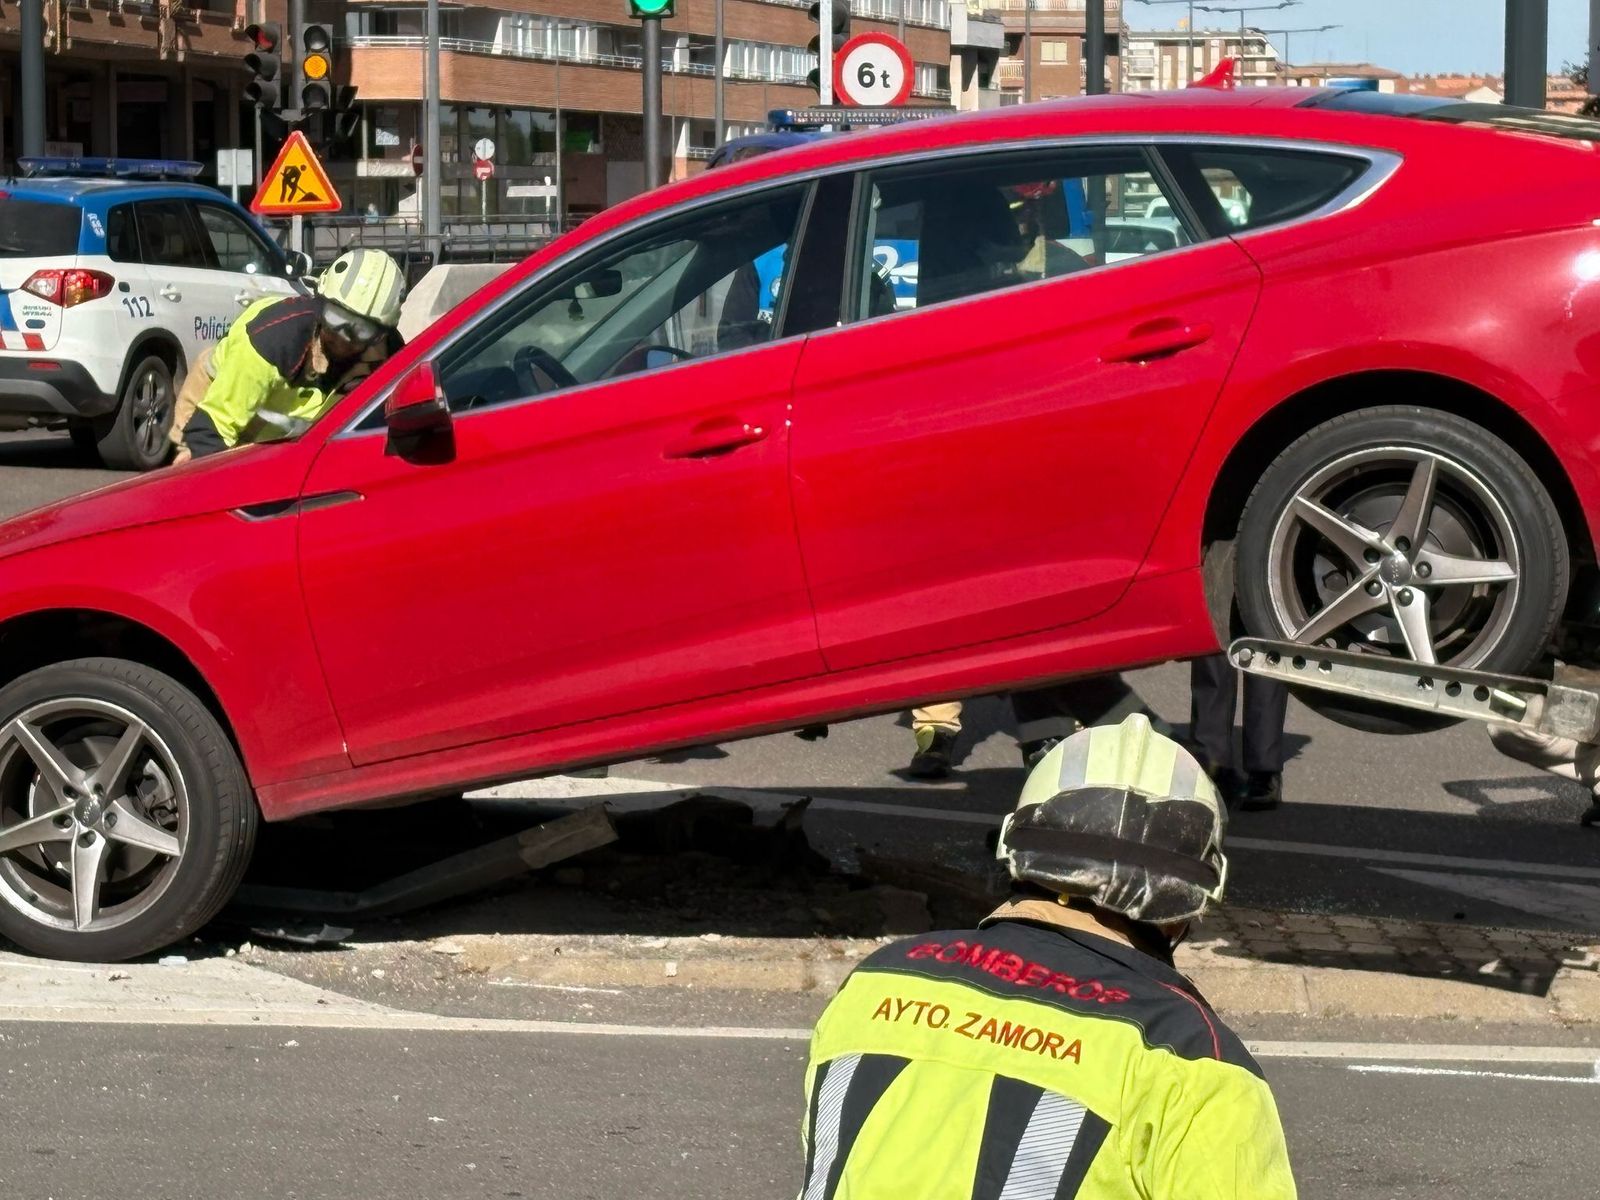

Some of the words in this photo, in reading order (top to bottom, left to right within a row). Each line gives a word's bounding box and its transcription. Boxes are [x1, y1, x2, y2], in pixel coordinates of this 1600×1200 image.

[857, 62, 876, 88] 6
[880, 70, 891, 88] t
[122, 297, 155, 319] 112
[906, 940, 1131, 1004] BOMBEROS
[871, 997, 950, 1029] AYTO.
[954, 1012, 1083, 1064] ZAMORA
